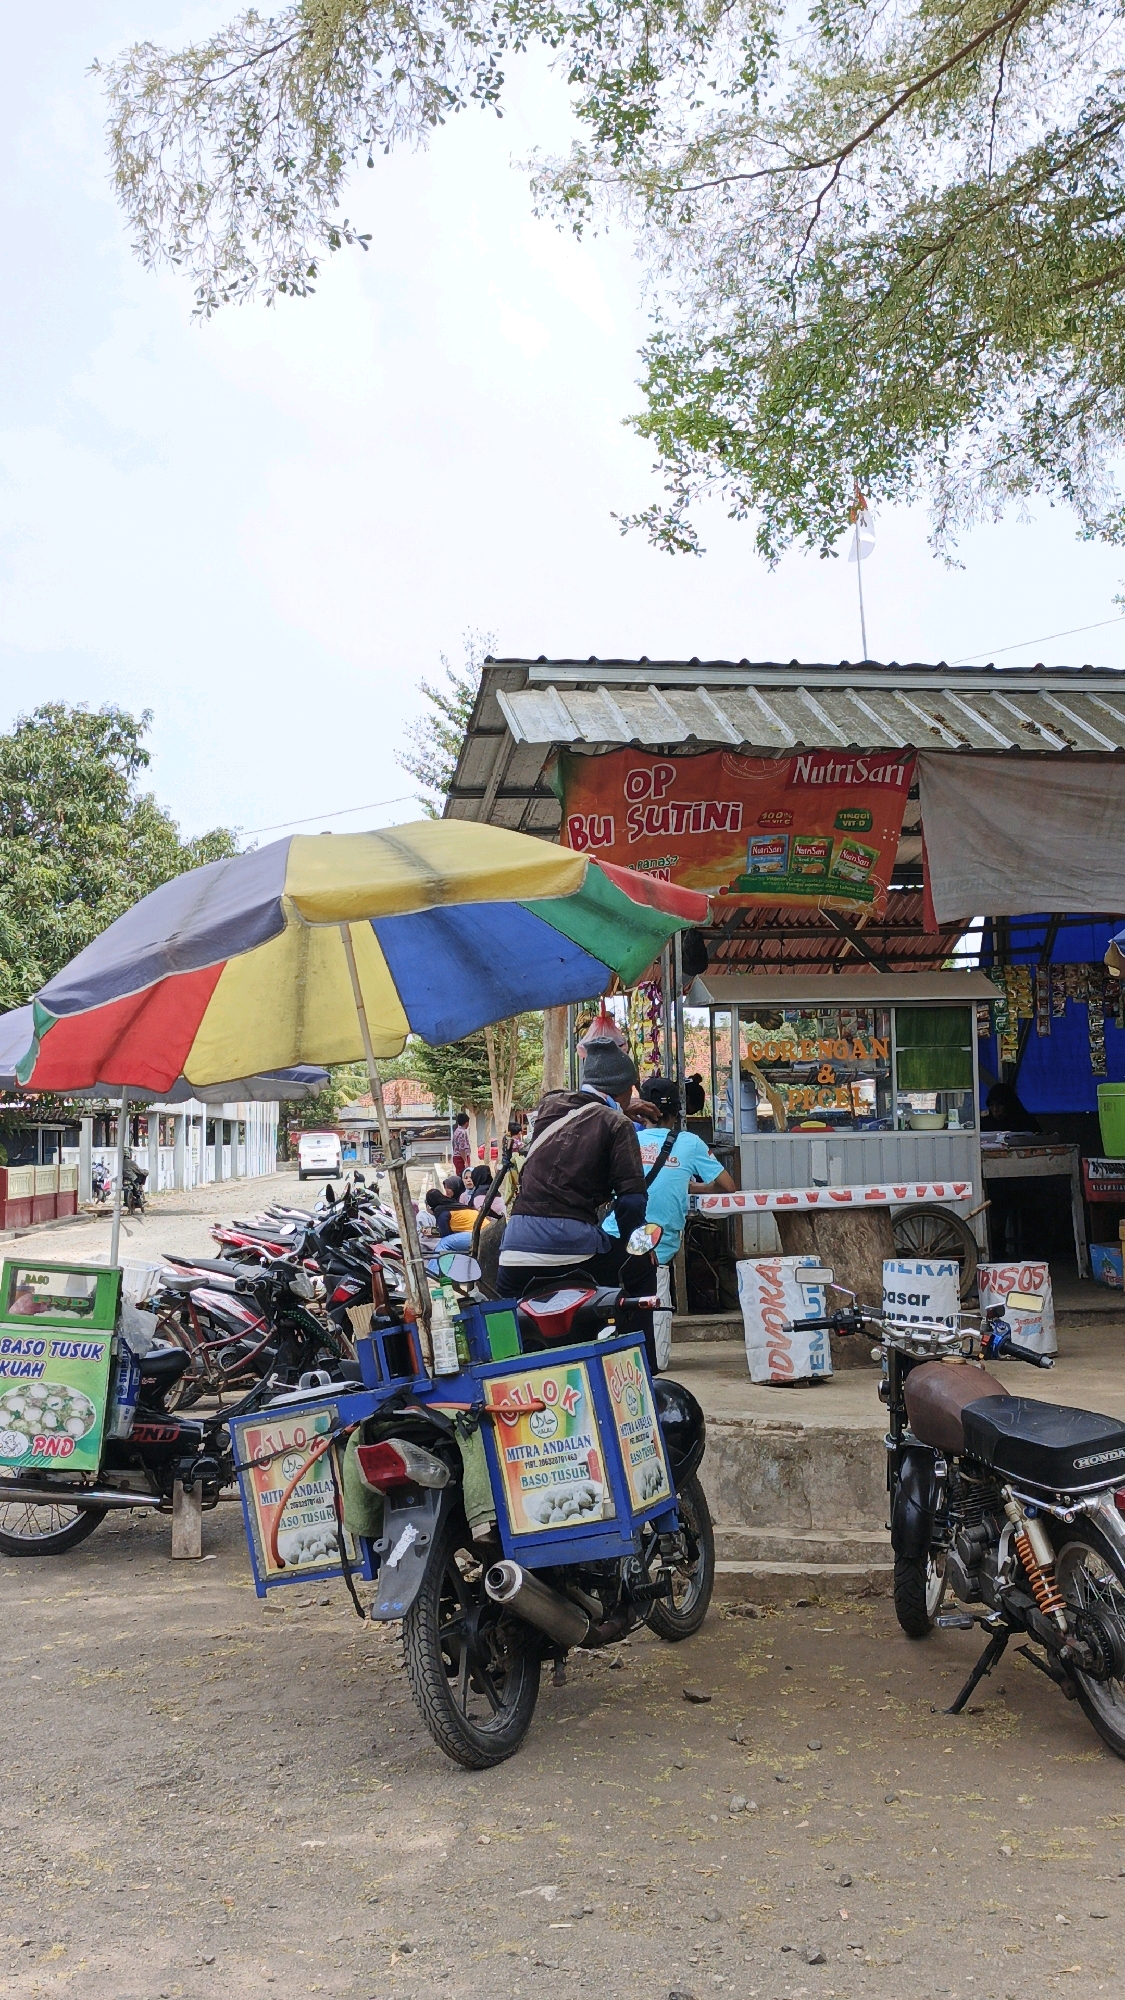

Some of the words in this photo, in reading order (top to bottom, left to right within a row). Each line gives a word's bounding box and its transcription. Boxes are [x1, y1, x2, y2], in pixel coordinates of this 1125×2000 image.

[792, 755, 904, 785] NutriSari
[624, 763, 677, 803] OP
[567, 813, 615, 852] BU
[747, 1036, 890, 1061] GORENGAN
[817, 1064, 836, 1084] &
[787, 1087, 869, 1111] PECEL
[24, 1273, 50, 1286] BASO
[0, 1337, 46, 1357] BASO
[50, 1340, 105, 1361] TUSUK
[0, 1359, 45, 1378] KUAH
[611, 1360, 643, 1403] CILOK
[500, 1379, 582, 1427] CILOK
[32, 1434, 75, 1457] PND
[254, 1427, 326, 1471] CILOK
[507, 1444, 540, 1461] MITRA
[543, 1434, 592, 1456] ANDALAN
[521, 1472, 549, 1487] BASO
[551, 1466, 588, 1481] TUSUK
[280, 1515, 299, 1529] ASO
[301, 1509, 334, 1524] TUSUK
